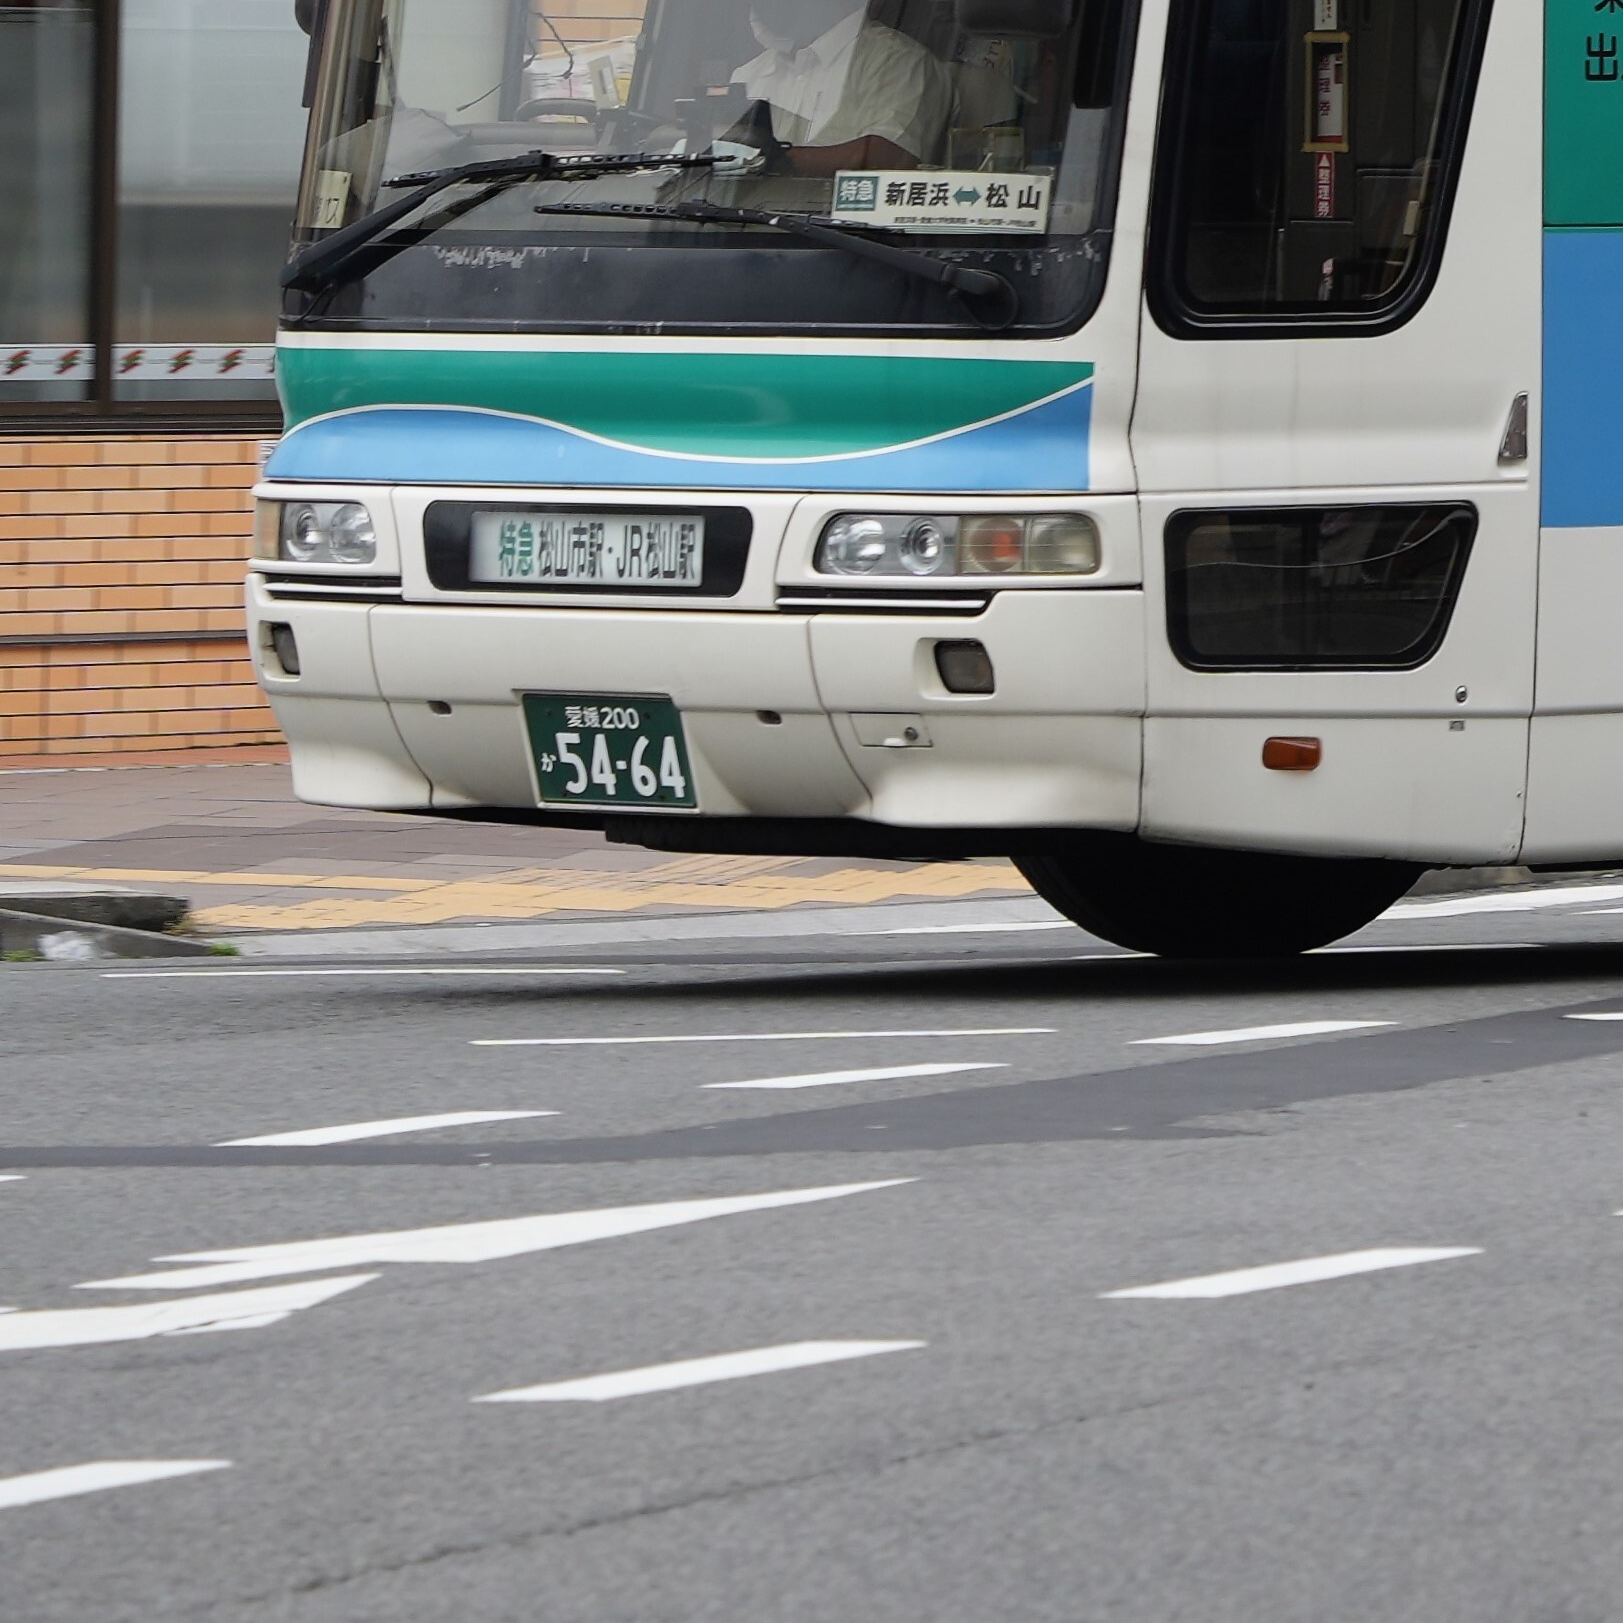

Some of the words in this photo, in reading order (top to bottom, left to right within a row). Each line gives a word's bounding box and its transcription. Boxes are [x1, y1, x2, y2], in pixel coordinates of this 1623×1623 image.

[840, 179, 874, 202] 特急
[885, 181, 950, 207] 新居浜
[985, 182, 1042, 210] 松山
[498, 519, 535, 577] 特急
[565, 706, 600, 728] 愛媛
[600, 706, 640, 729] 200
[541, 752, 557, 773] か
[555, 732, 686, 798] 54-64
